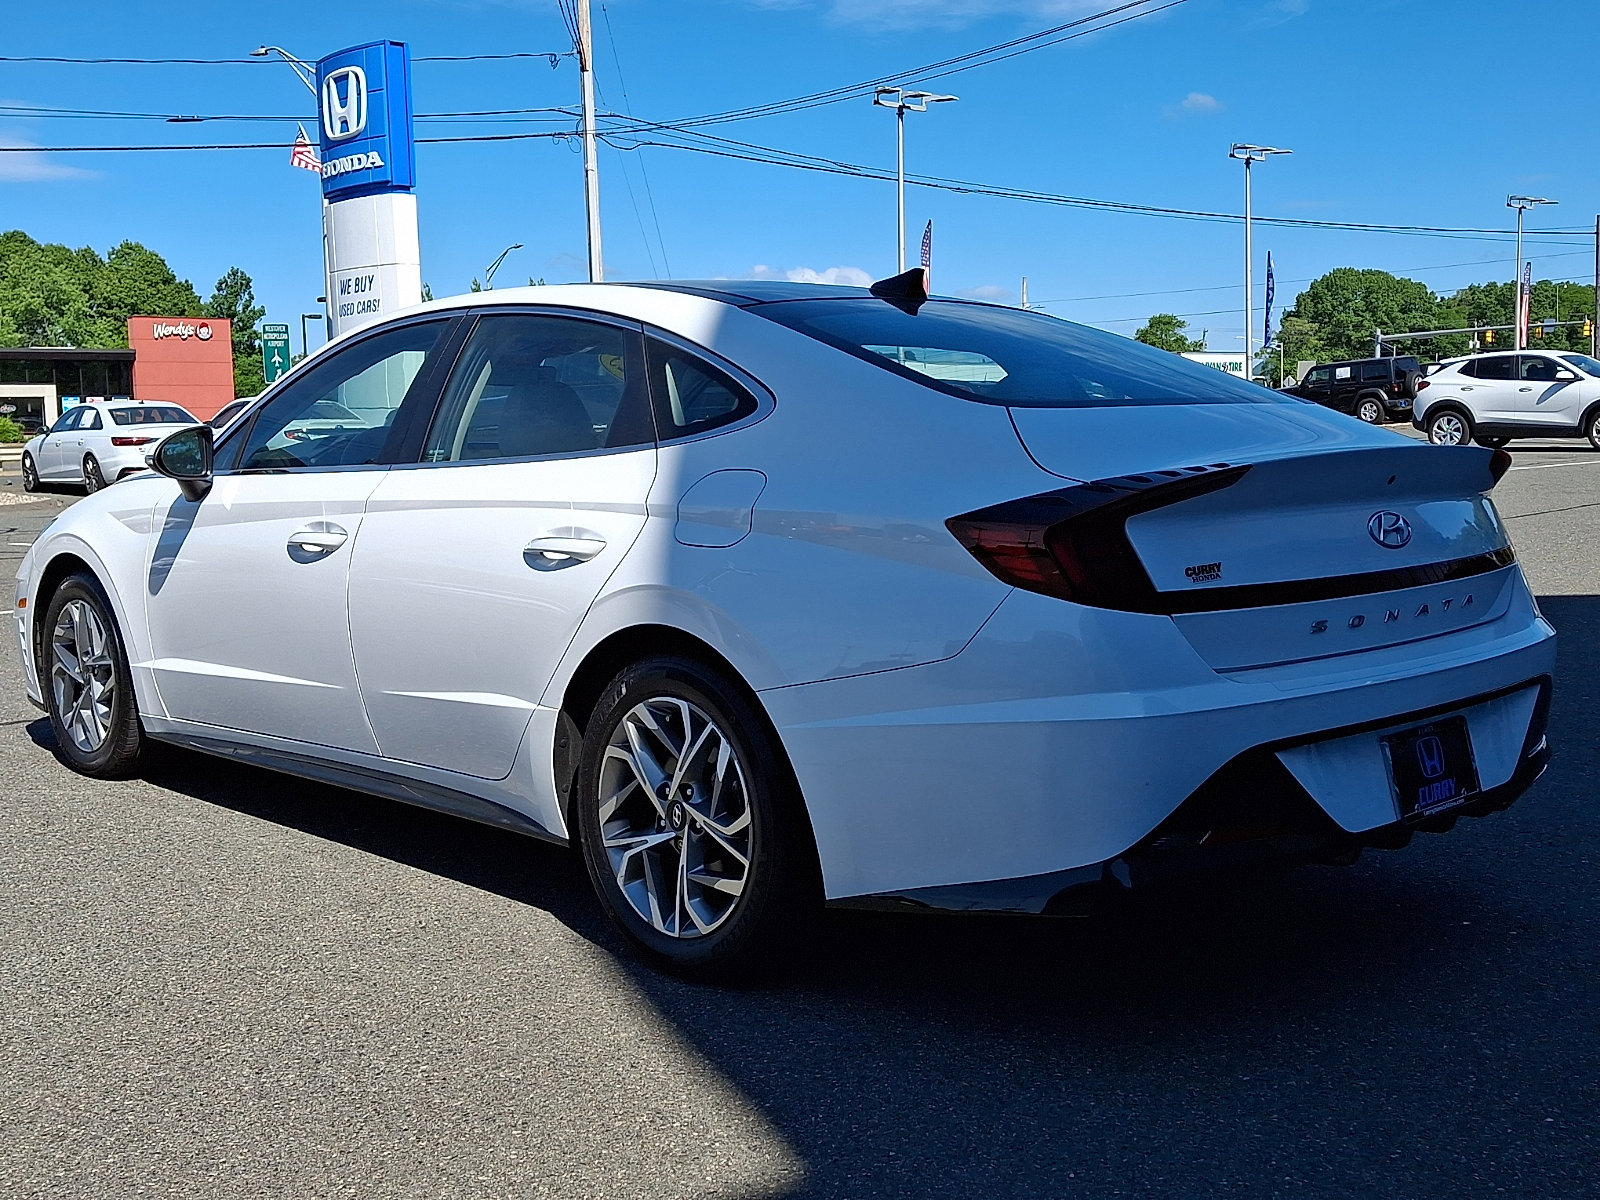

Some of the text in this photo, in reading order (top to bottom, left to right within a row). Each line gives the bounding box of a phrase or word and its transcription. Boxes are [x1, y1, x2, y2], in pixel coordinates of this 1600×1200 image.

[322, 151, 384, 179] HONDA
[340, 274, 375, 296] WE BUY
[339, 298, 380, 318] USED CARS!
[153, 321, 195, 340] Wendy's
[1229, 362, 1242, 372] TIRE
[1184, 561, 1222, 578] CURRY
[1191, 572, 1222, 583] HONDA
[1309, 593, 1475, 634] SONATA
[1418, 777, 1456, 807] CURRY
